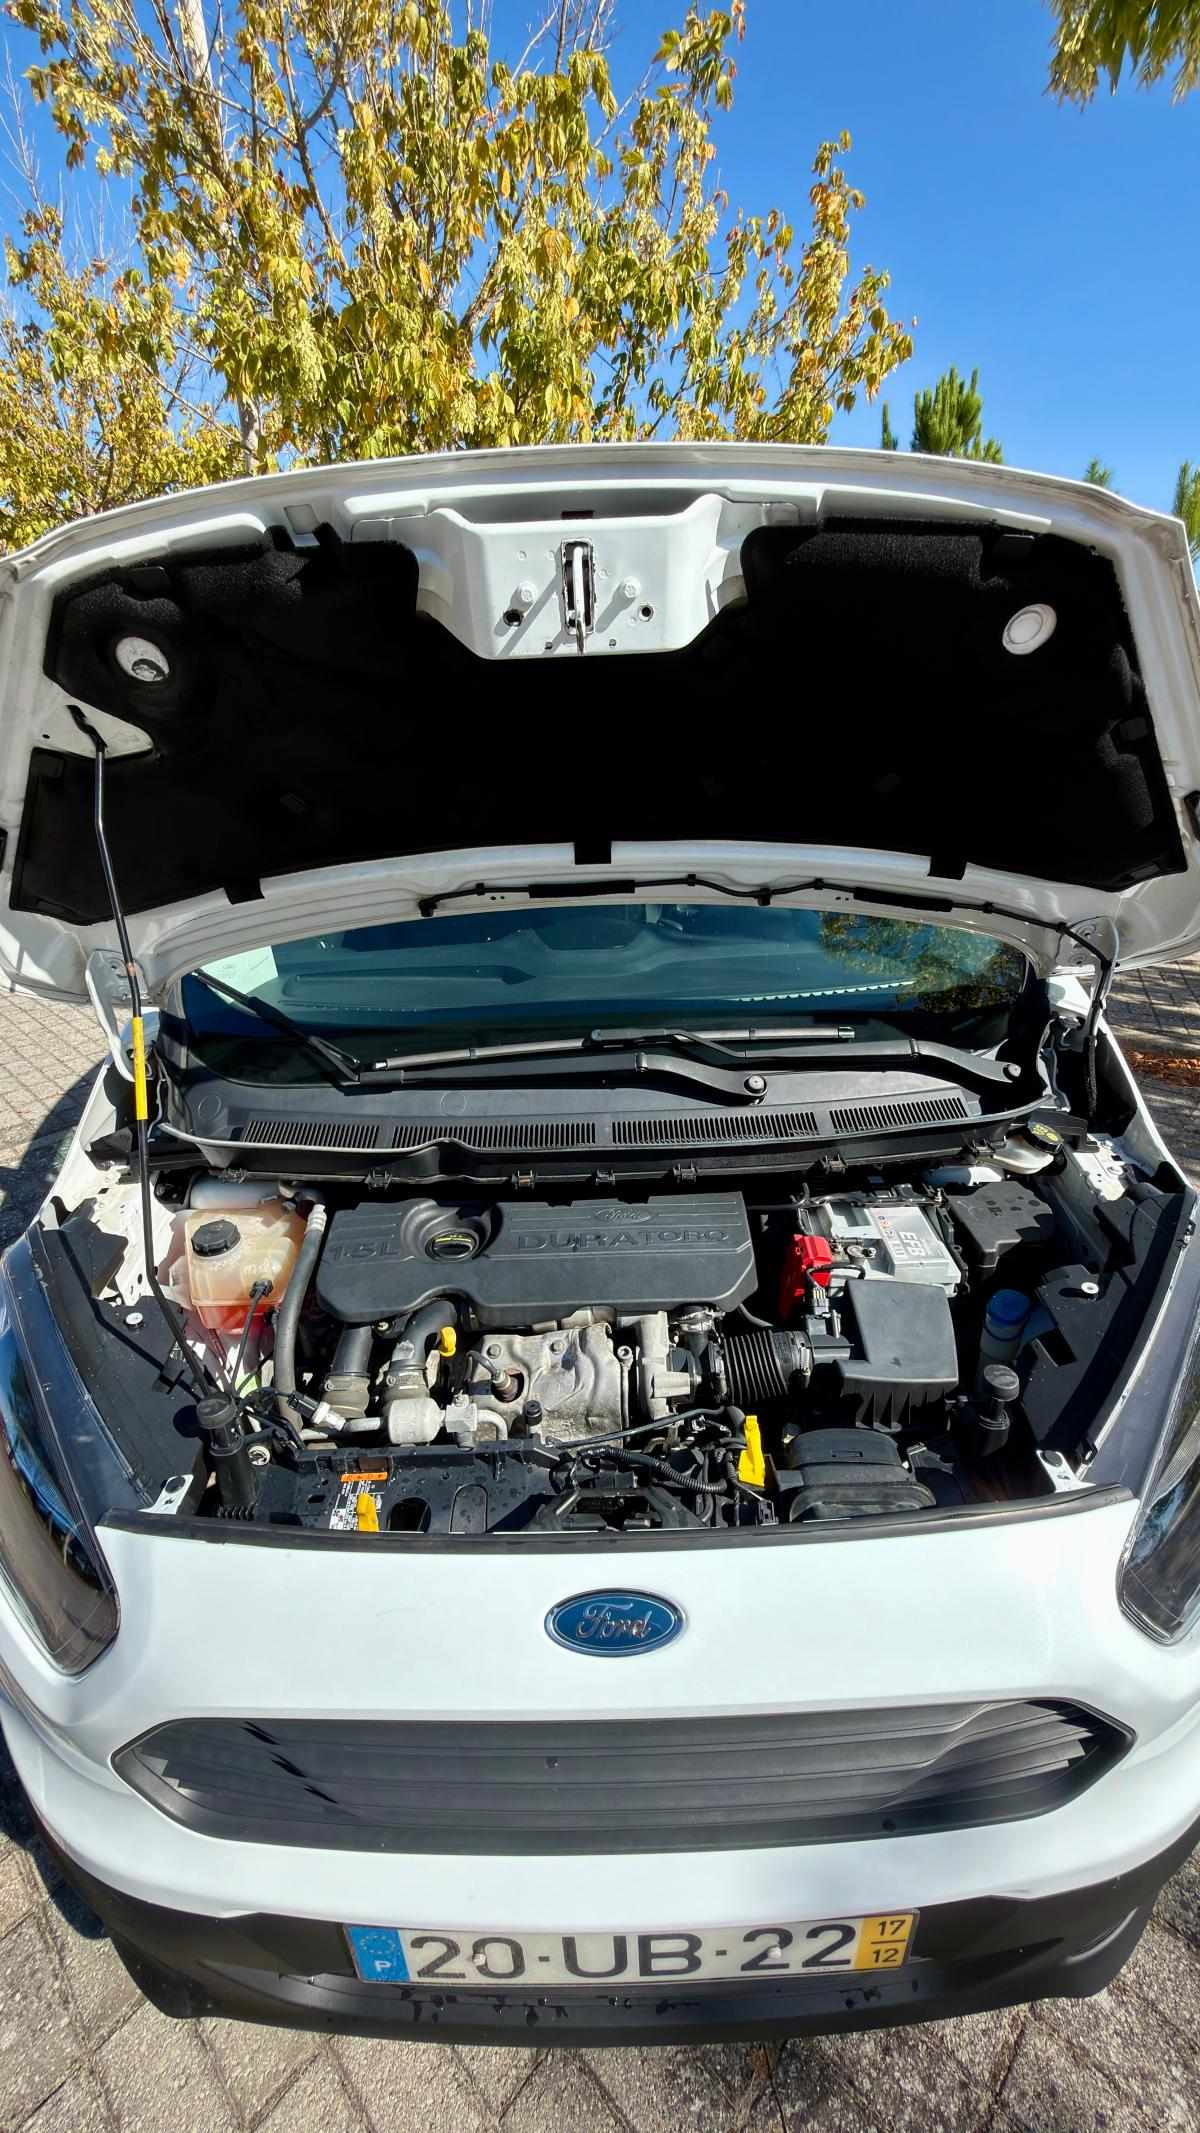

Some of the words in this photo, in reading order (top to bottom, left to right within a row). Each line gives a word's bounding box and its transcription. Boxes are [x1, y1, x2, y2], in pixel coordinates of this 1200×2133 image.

[900, 1232, 926, 1256] EFB
[575, 1602, 653, 1640] Ford
[878, 1920, 905, 1936] 17
[873, 1949, 898, 1963] 12
[375, 1960, 391, 1972] P
